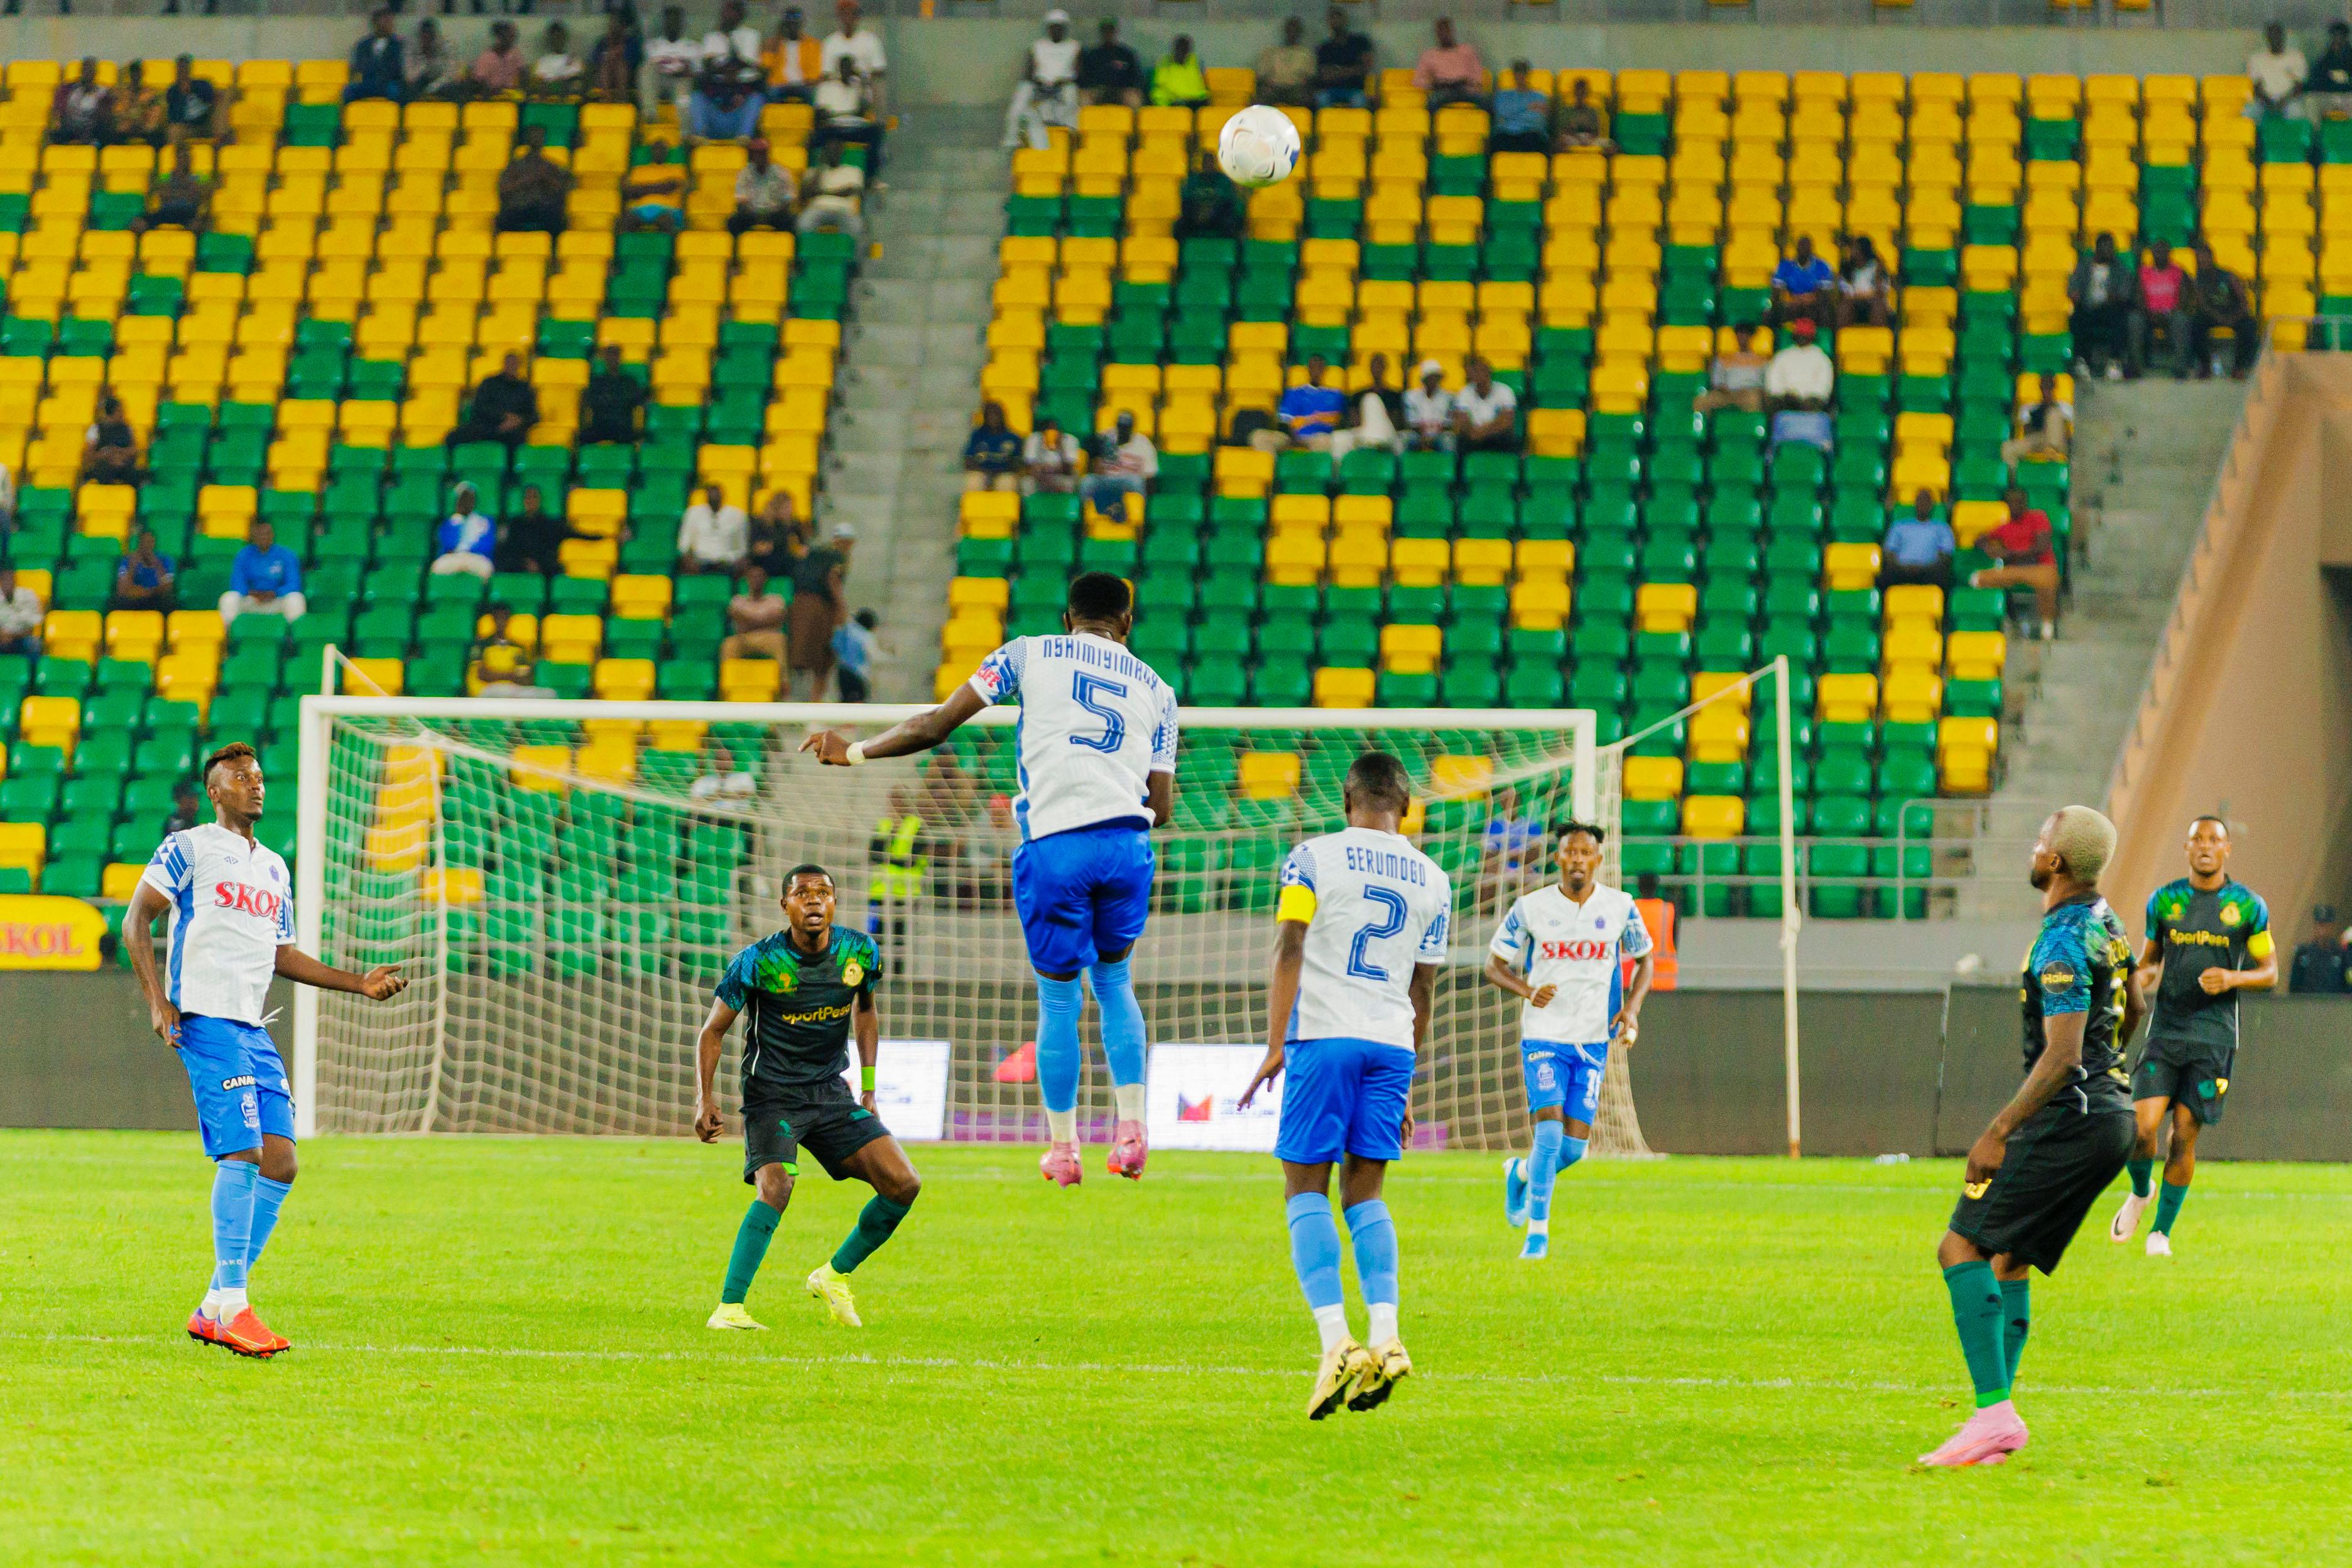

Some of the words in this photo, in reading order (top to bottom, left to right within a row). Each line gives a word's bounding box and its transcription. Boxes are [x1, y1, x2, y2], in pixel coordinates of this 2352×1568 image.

[1069, 670, 1128, 754] 5
[1346, 846, 1426, 886] SERUMOGO
[1347, 884, 1407, 981] 2
[1542, 940, 1609, 961] SKOL
[2042, 972, 2074, 984] Haier
